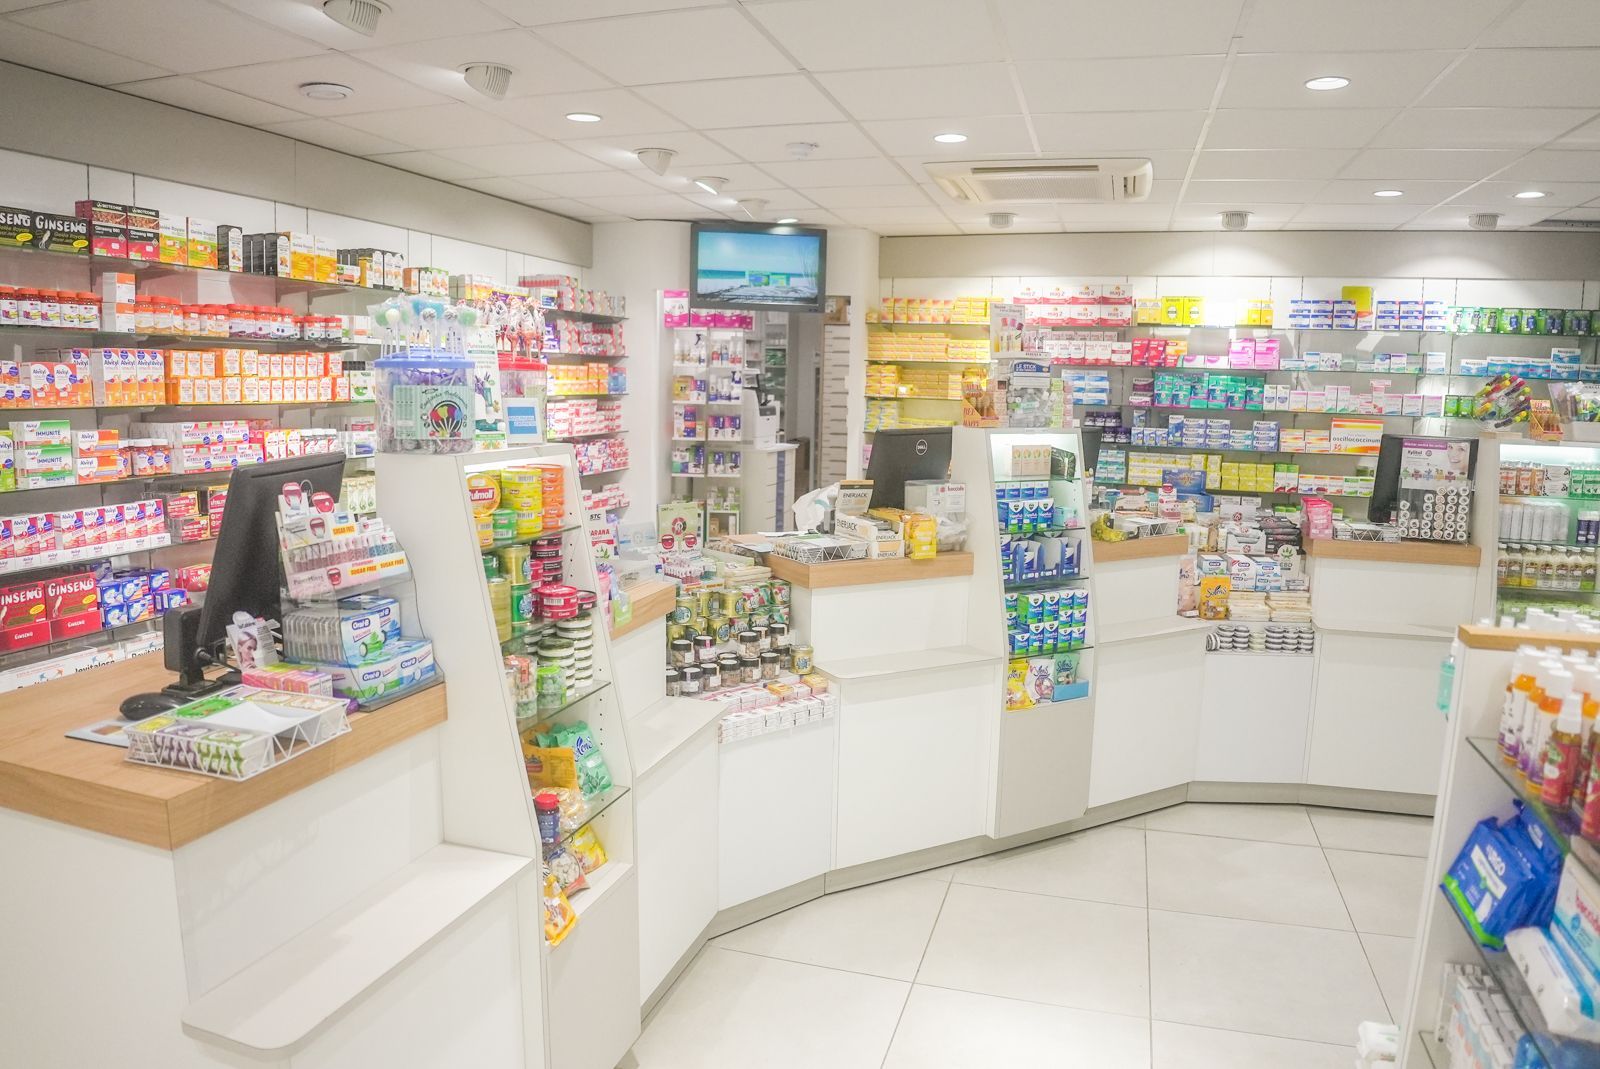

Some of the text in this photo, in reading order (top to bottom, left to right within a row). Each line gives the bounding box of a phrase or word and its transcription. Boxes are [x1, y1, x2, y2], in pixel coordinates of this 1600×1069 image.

[0, 213, 31, 227] SENG
[36, 215, 86, 234] GINSENG
[836, 518, 858, 531] ENERJACK
[351, 567, 365, 575] SUGAR
[48, 578, 94, 597] GINSENG
[1, 587, 42, 605] INSENG
[379, 608, 389, 616] al-B
[353, 620, 370, 628] Oral-B
[14, 632, 33, 640] GINSENG
[364, 672, 380, 680] Oral-B
